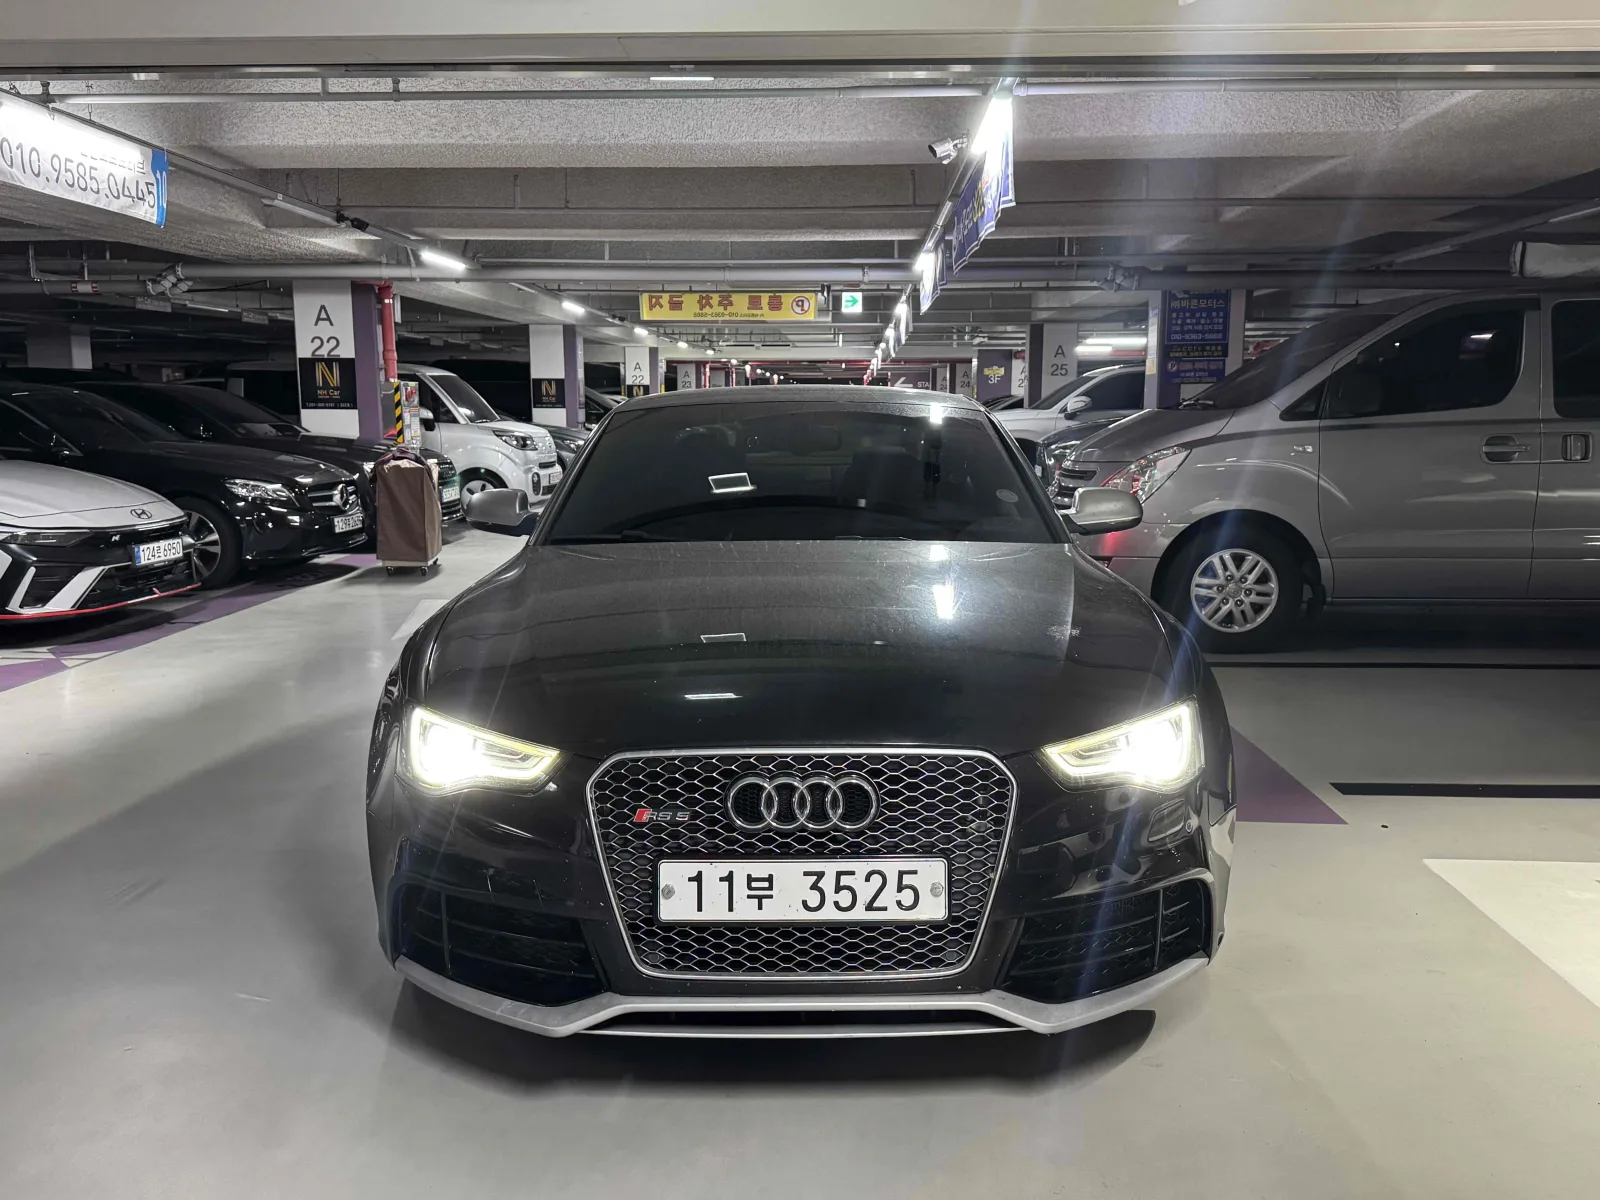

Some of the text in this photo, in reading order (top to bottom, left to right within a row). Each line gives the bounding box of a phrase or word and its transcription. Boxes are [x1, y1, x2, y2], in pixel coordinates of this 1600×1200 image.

[314, 304, 334, 326] A
[310, 336, 341, 358] 22
[1053, 345, 1066, 358] A
[634, 362, 642, 372] A
[1050, 364, 1069, 377] 25
[631, 375, 645, 385] 22
[683, 371, 690, 379] A
[962, 371, 969, 379] A
[988, 374, 1002, 384] 3F
[681, 381, 692, 389] 23
[960, 381, 970, 389] 24
[163, 541, 181, 557] 6950
[687, 869, 920, 913] 11부 3525
